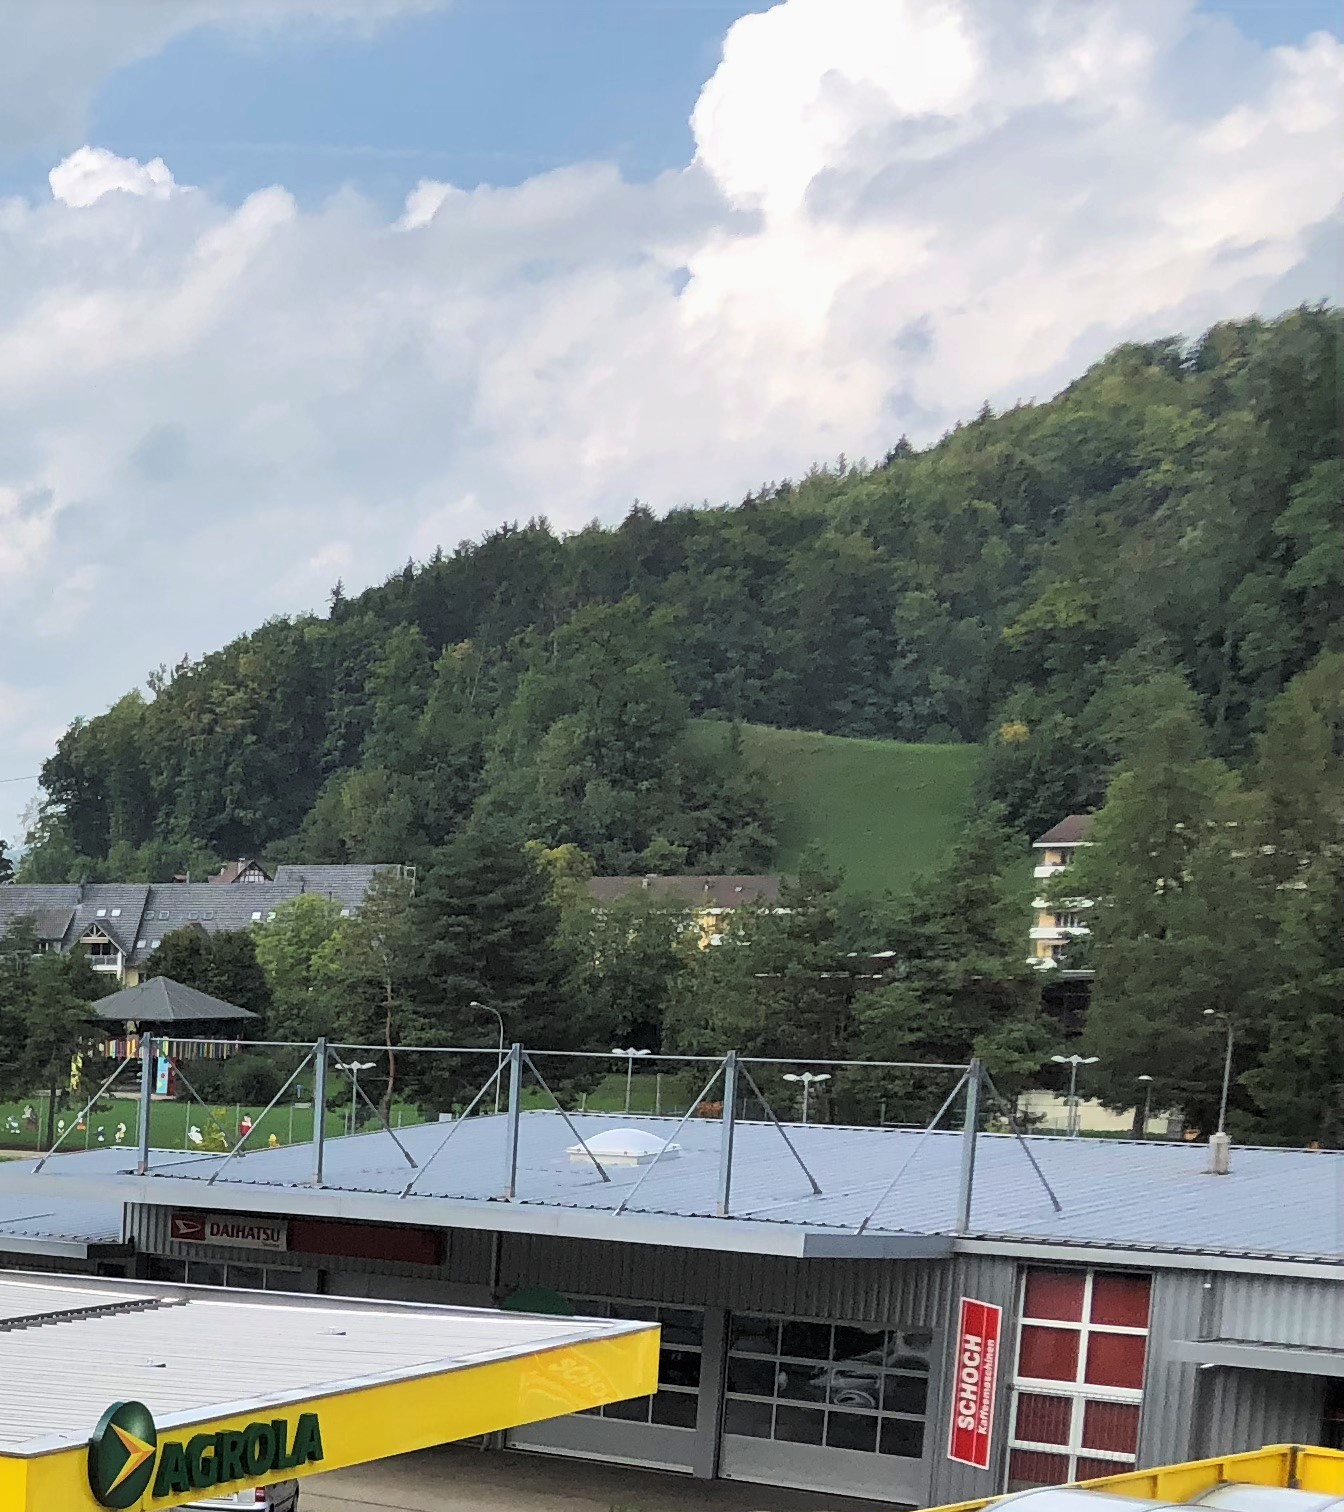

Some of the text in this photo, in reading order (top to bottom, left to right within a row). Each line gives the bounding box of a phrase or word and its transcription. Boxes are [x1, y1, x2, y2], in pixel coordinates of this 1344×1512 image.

[209, 1221, 281, 1243] DAIHATSU
[957, 1334, 982, 1431] SCHOCH
[977, 1339, 995, 1435] Kaffeemaschinen
[152, 1413, 325, 1499] AGROLA
